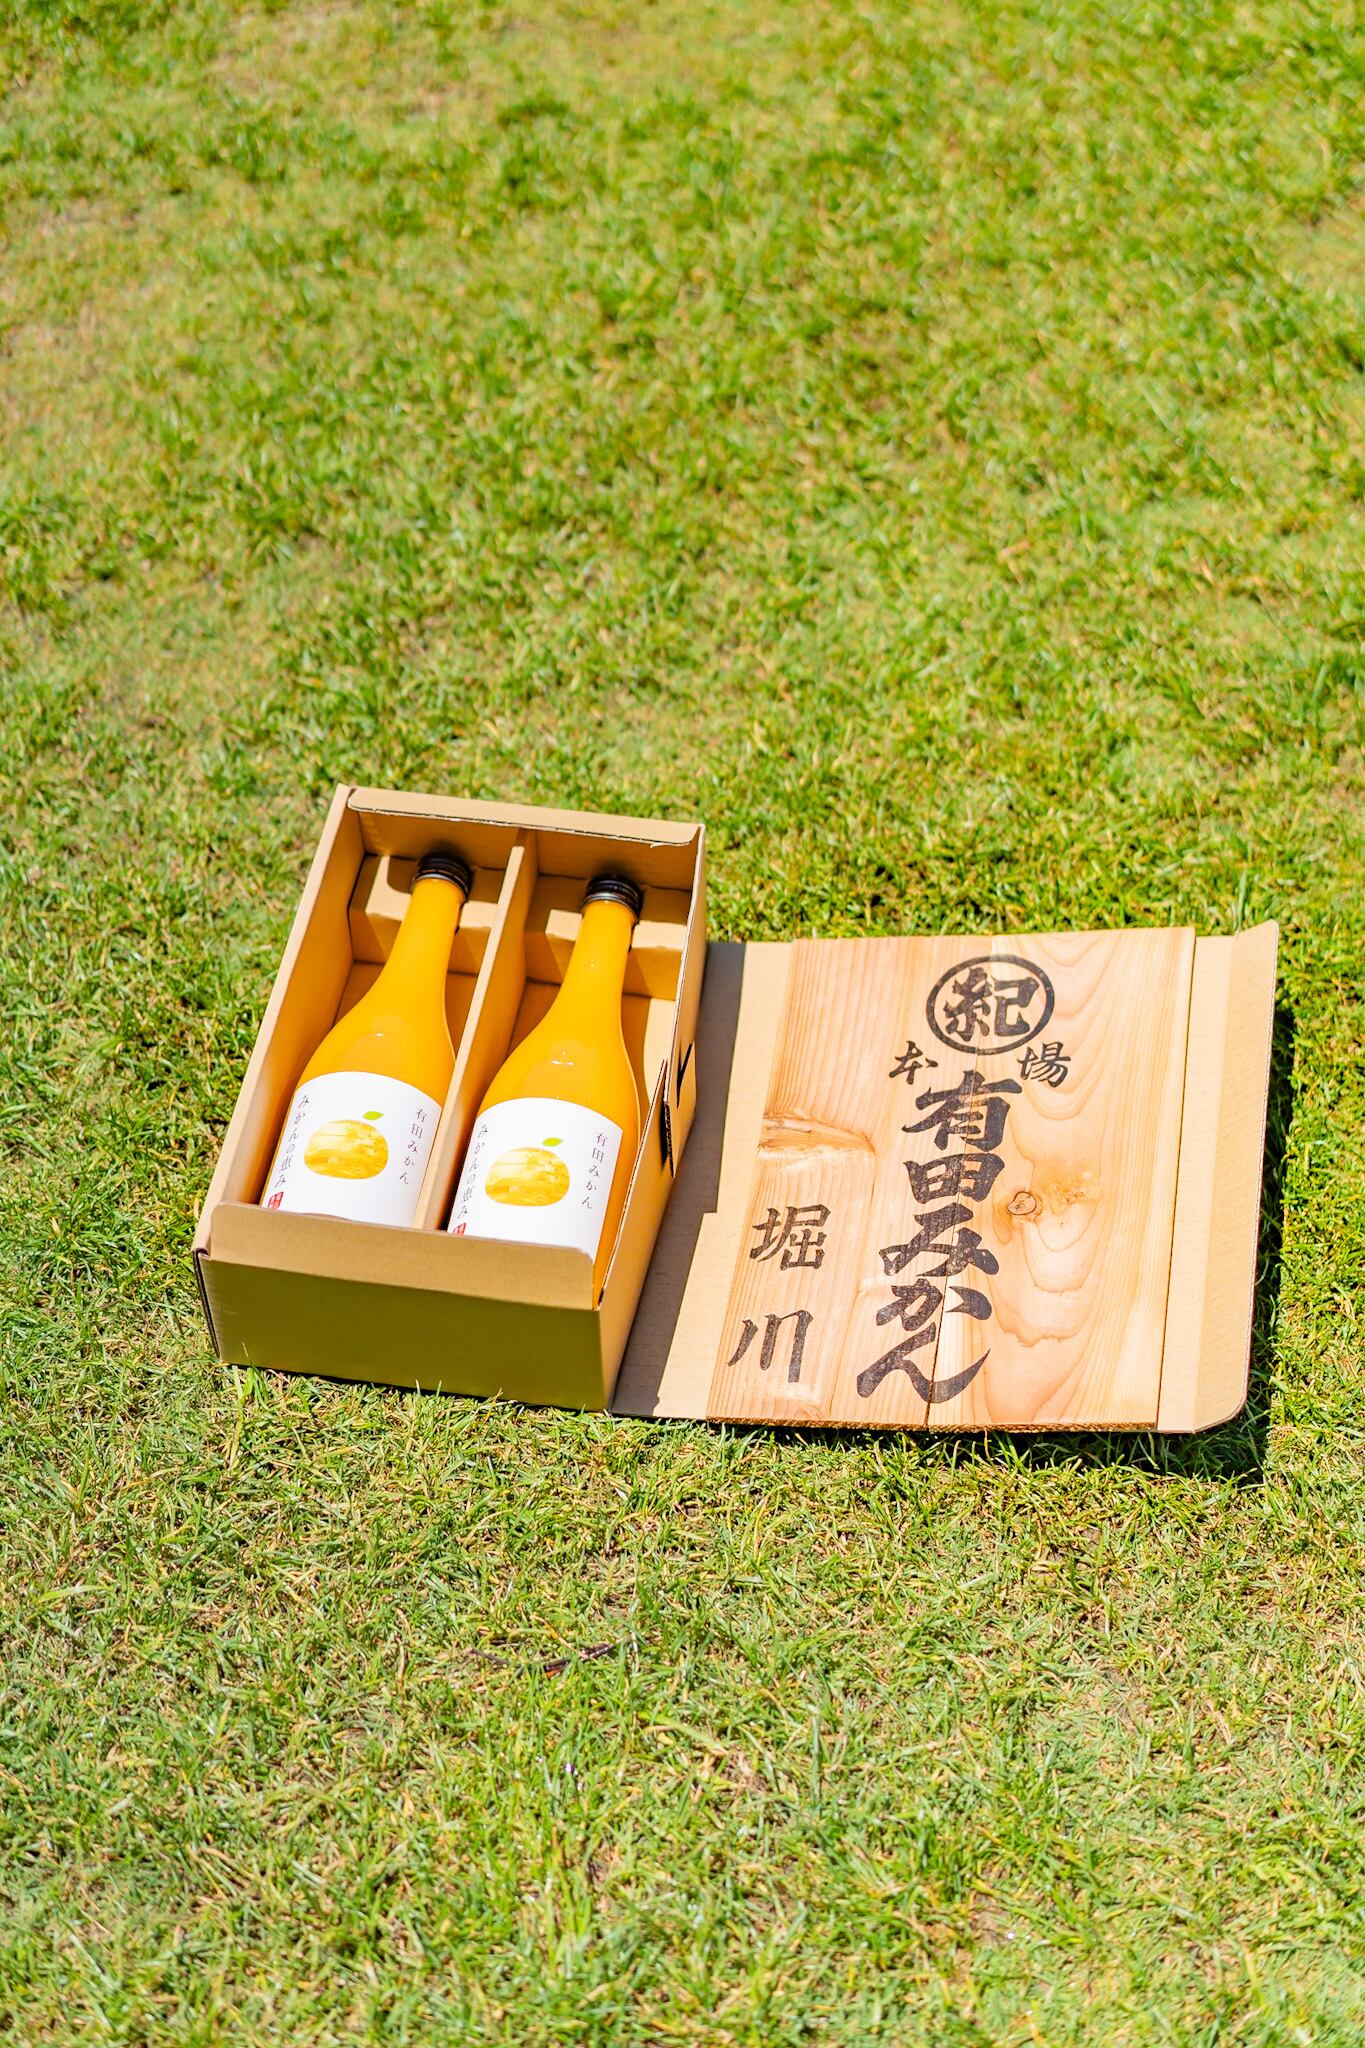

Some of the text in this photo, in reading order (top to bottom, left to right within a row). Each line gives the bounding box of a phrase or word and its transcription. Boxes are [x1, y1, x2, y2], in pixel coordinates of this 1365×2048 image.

[943, 965, 1041, 1044] 紀
[399, 1107, 428, 1186] 有田みかん
[581, 1131, 608, 1211] 有田みかん
[857, 1069, 1024, 1404] 有田みかん
[727, 1203, 832, 1383] 堀川
